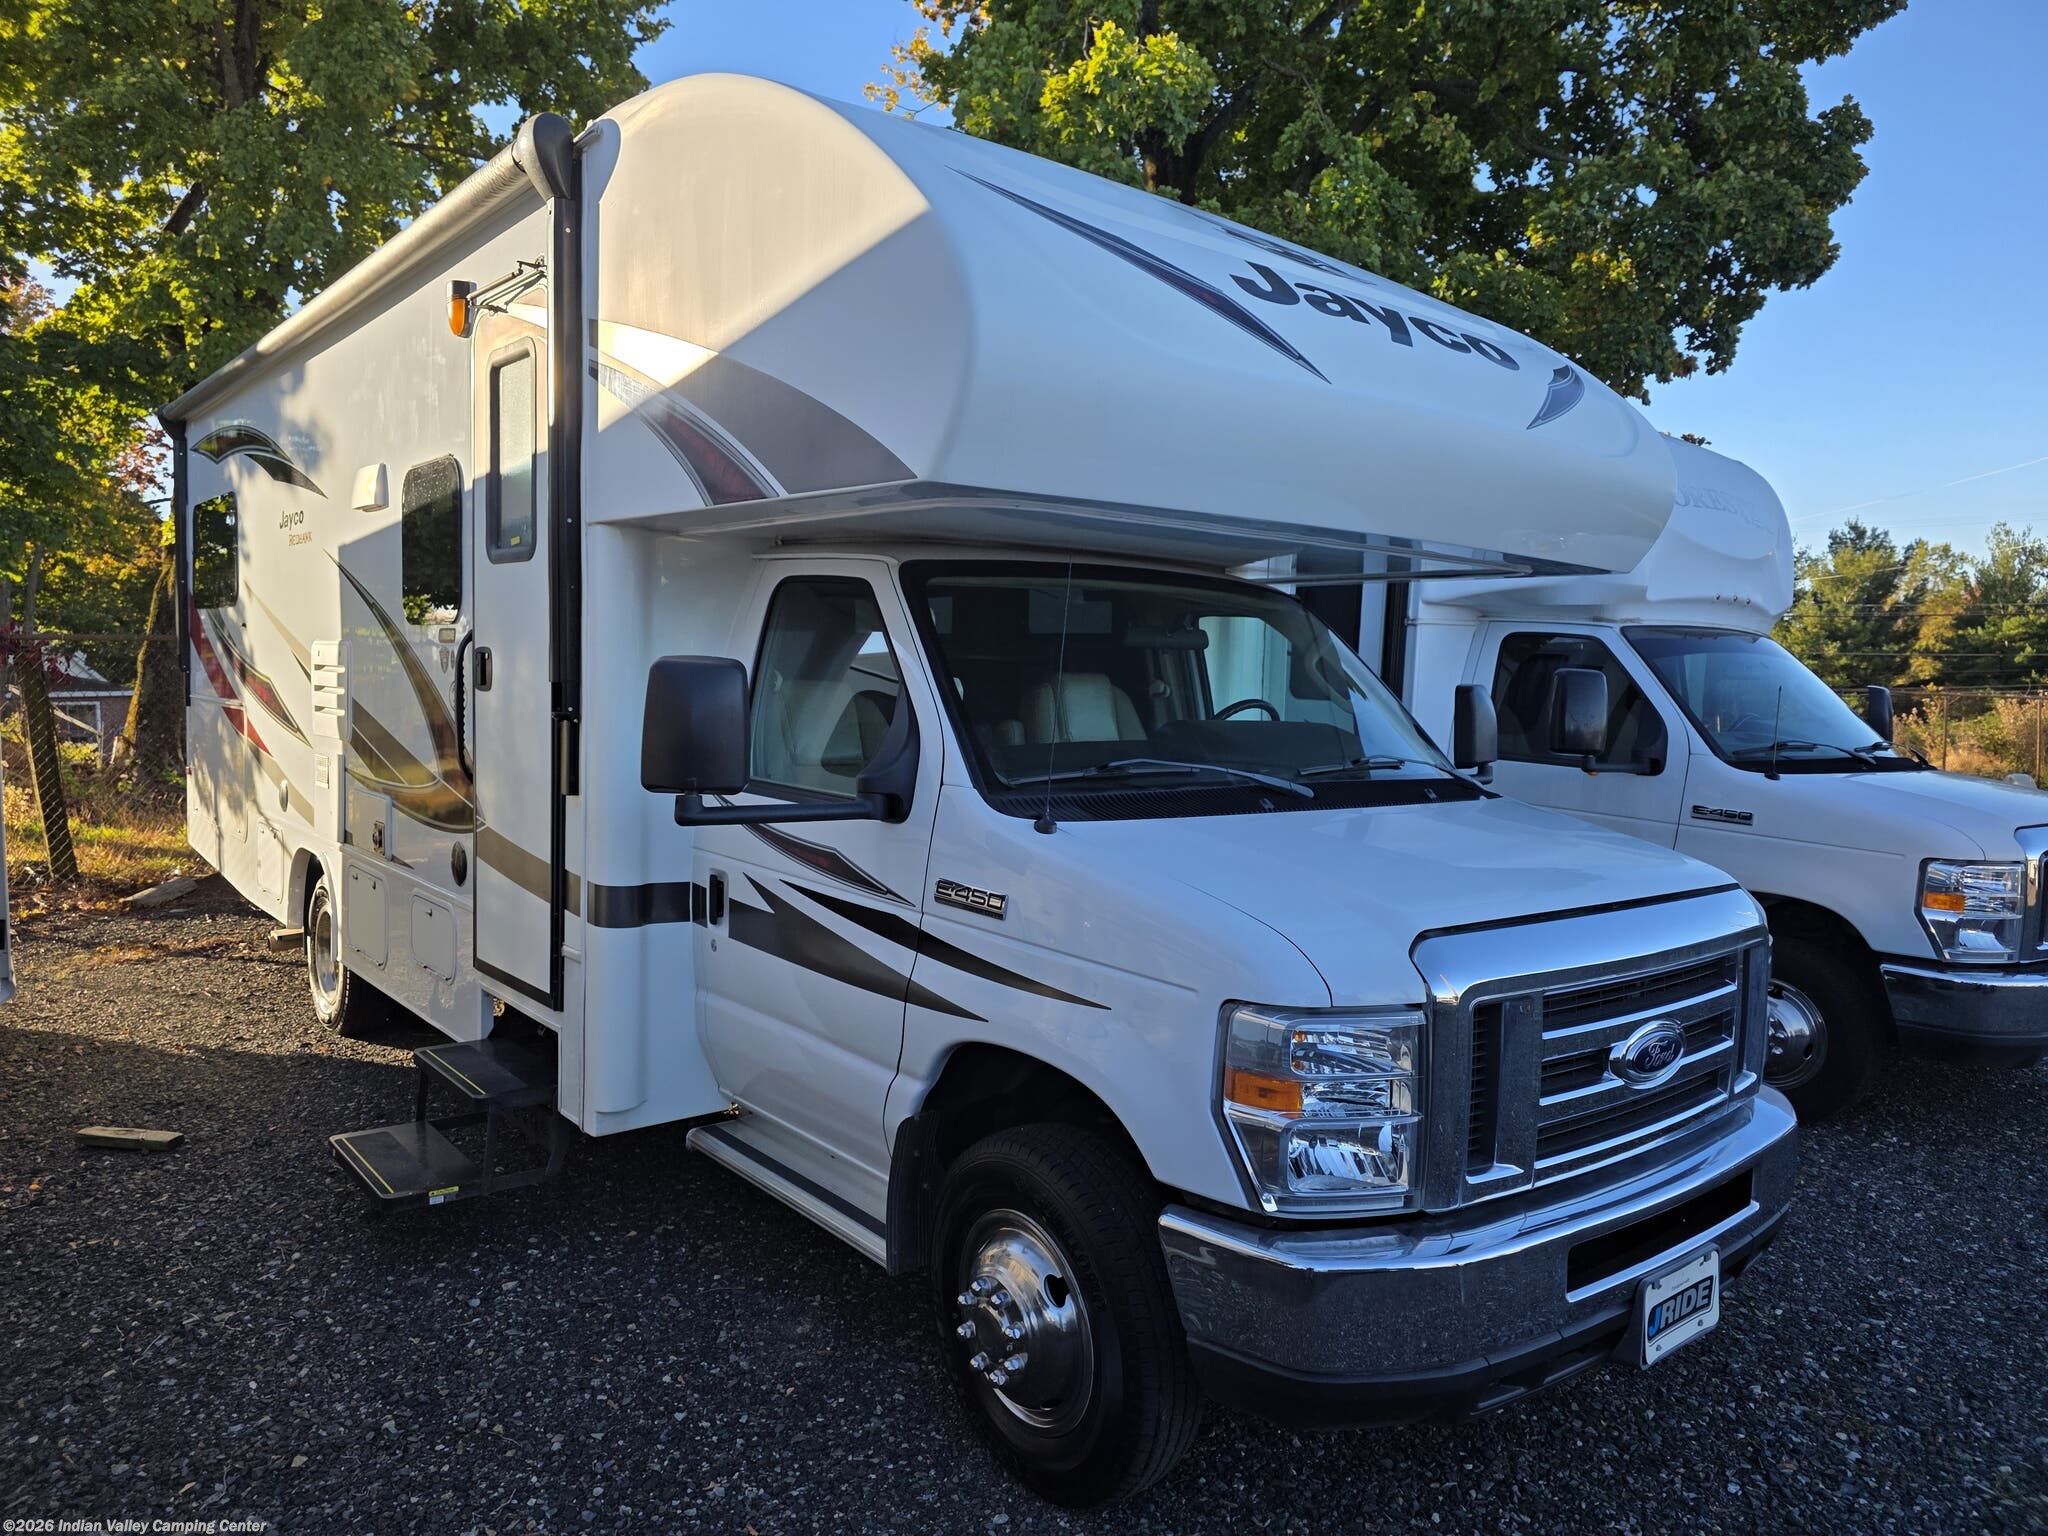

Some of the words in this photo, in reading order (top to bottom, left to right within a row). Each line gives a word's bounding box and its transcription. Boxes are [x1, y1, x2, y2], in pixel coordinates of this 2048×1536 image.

[1229, 259, 1520, 371] Jayco
[279, 509, 305, 531] Jayco
[1644, 1039, 1675, 1067] Ford
[1648, 1280, 1712, 1337] JRIDE
